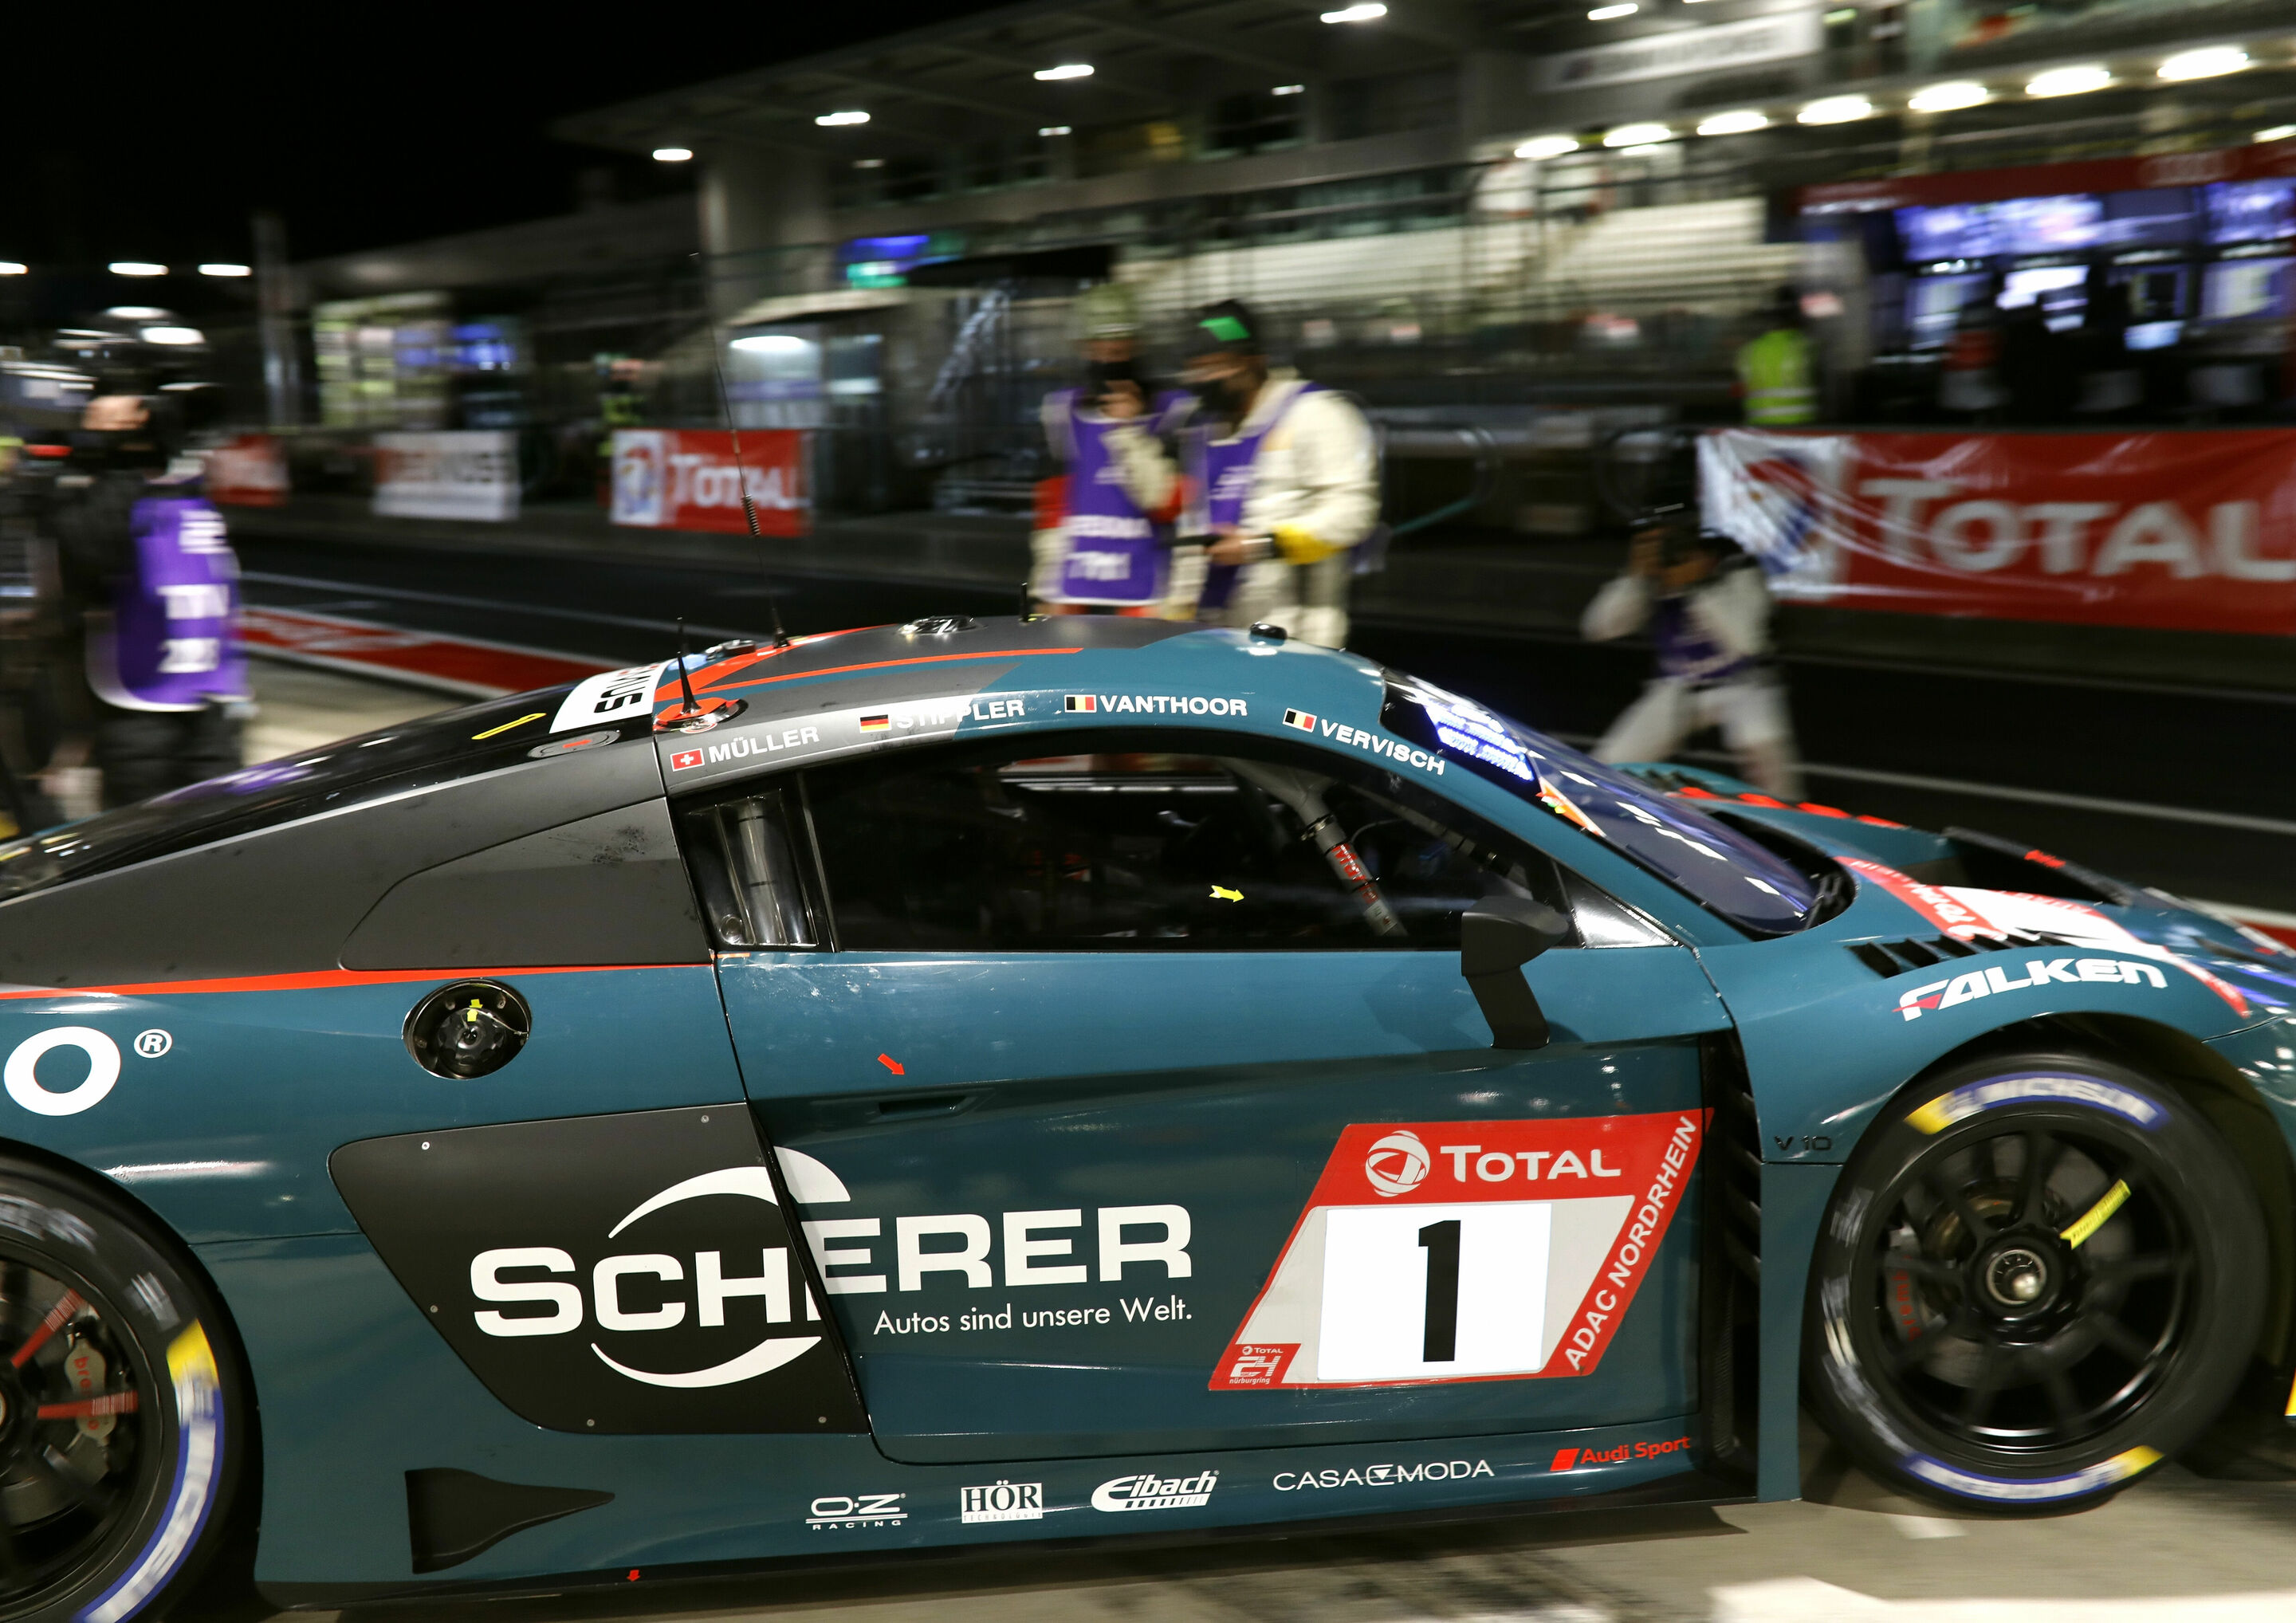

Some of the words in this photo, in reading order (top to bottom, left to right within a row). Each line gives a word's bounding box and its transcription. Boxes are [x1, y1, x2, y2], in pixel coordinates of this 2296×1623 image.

[1859, 477, 2296, 582] TOTAL
[1099, 694, 1248, 717] VANTHOOR
[709, 725, 820, 764] MÜLLER
[1320, 718, 1446, 776] VERVISCH
[1894, 958, 2168, 1021] FALKEN
[1441, 1144, 1622, 1183] TOTAL
[1563, 1292, 1618, 1371] ADAC
[1609, 1115, 1697, 1288] NORDRHEIN
[470, 1204, 1193, 1338] SCHERER
[1417, 1220, 1462, 1363] 1
[873, 1310, 951, 1336] Autos
[960, 1303, 1012, 1331] sind
[1022, 1306, 1111, 1327] unsere
[1119, 1295, 1193, 1323] Welt.
[1229, 1377, 1271, 1385] nürburgring
[1580, 1444, 1630, 1465] Audi
[1634, 1435, 1692, 1460] Sport
[963, 1480, 1040, 1513] HÖR
[1091, 1470, 1218, 1512] Eibach
[812, 1519, 902, 1531] RACING
